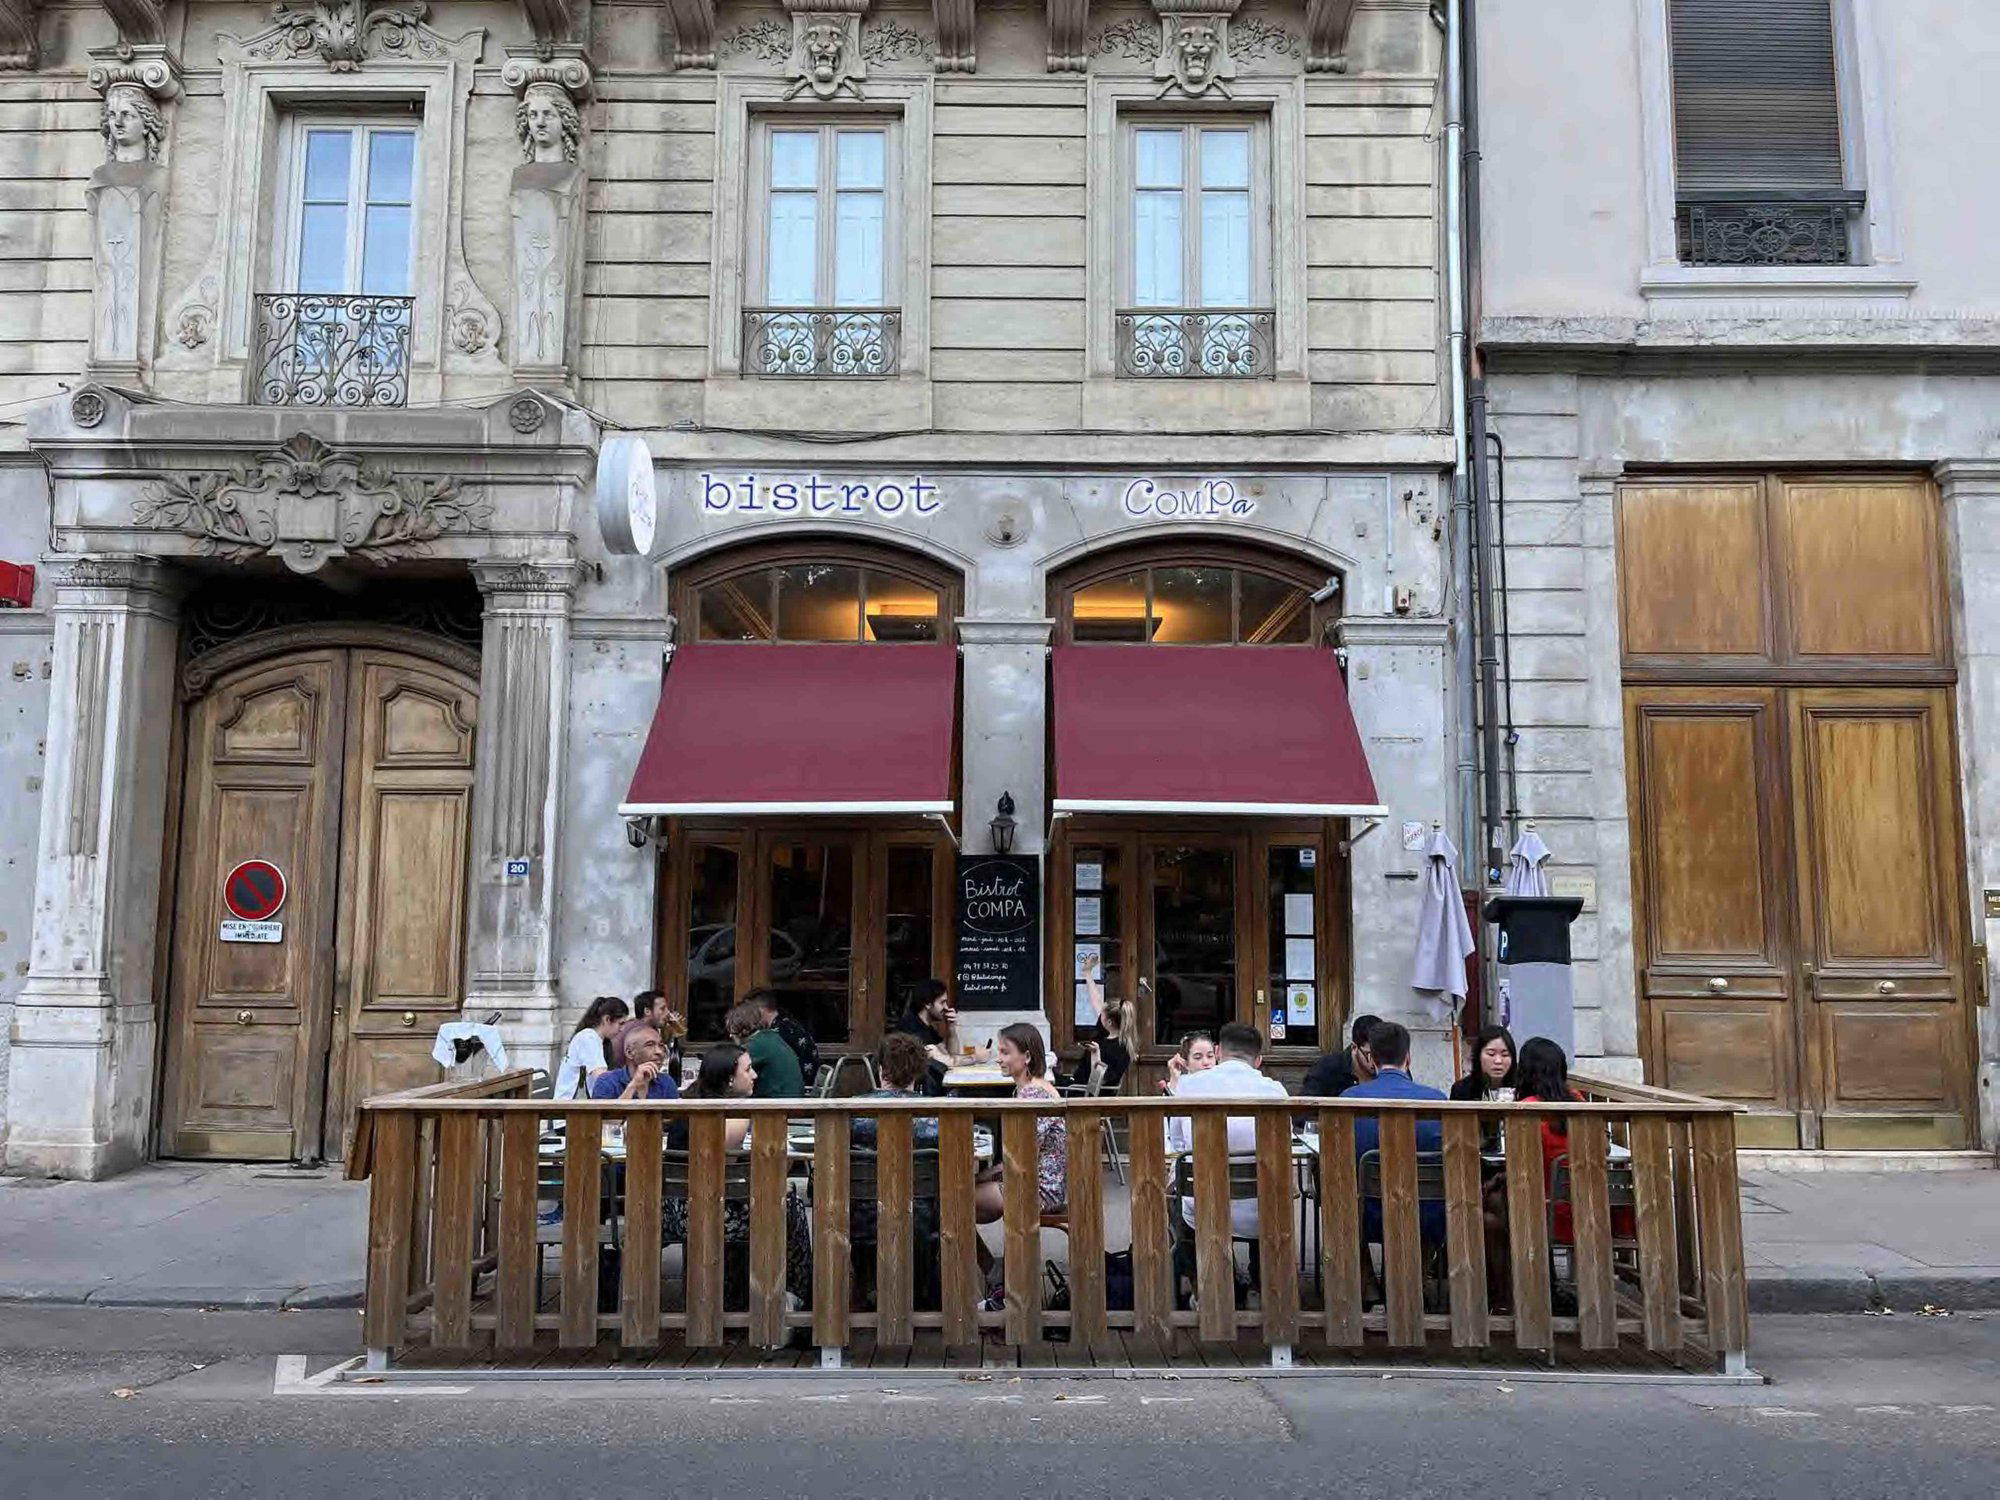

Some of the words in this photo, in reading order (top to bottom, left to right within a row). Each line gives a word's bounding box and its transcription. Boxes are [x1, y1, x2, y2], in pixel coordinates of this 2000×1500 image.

[701, 473, 939, 512] bistrot
[510, 864, 525, 873] 20
[965, 875, 1024, 899] Bistrot
[967, 899, 1026, 920] COMPA
[1500, 931, 1508, 958] P
